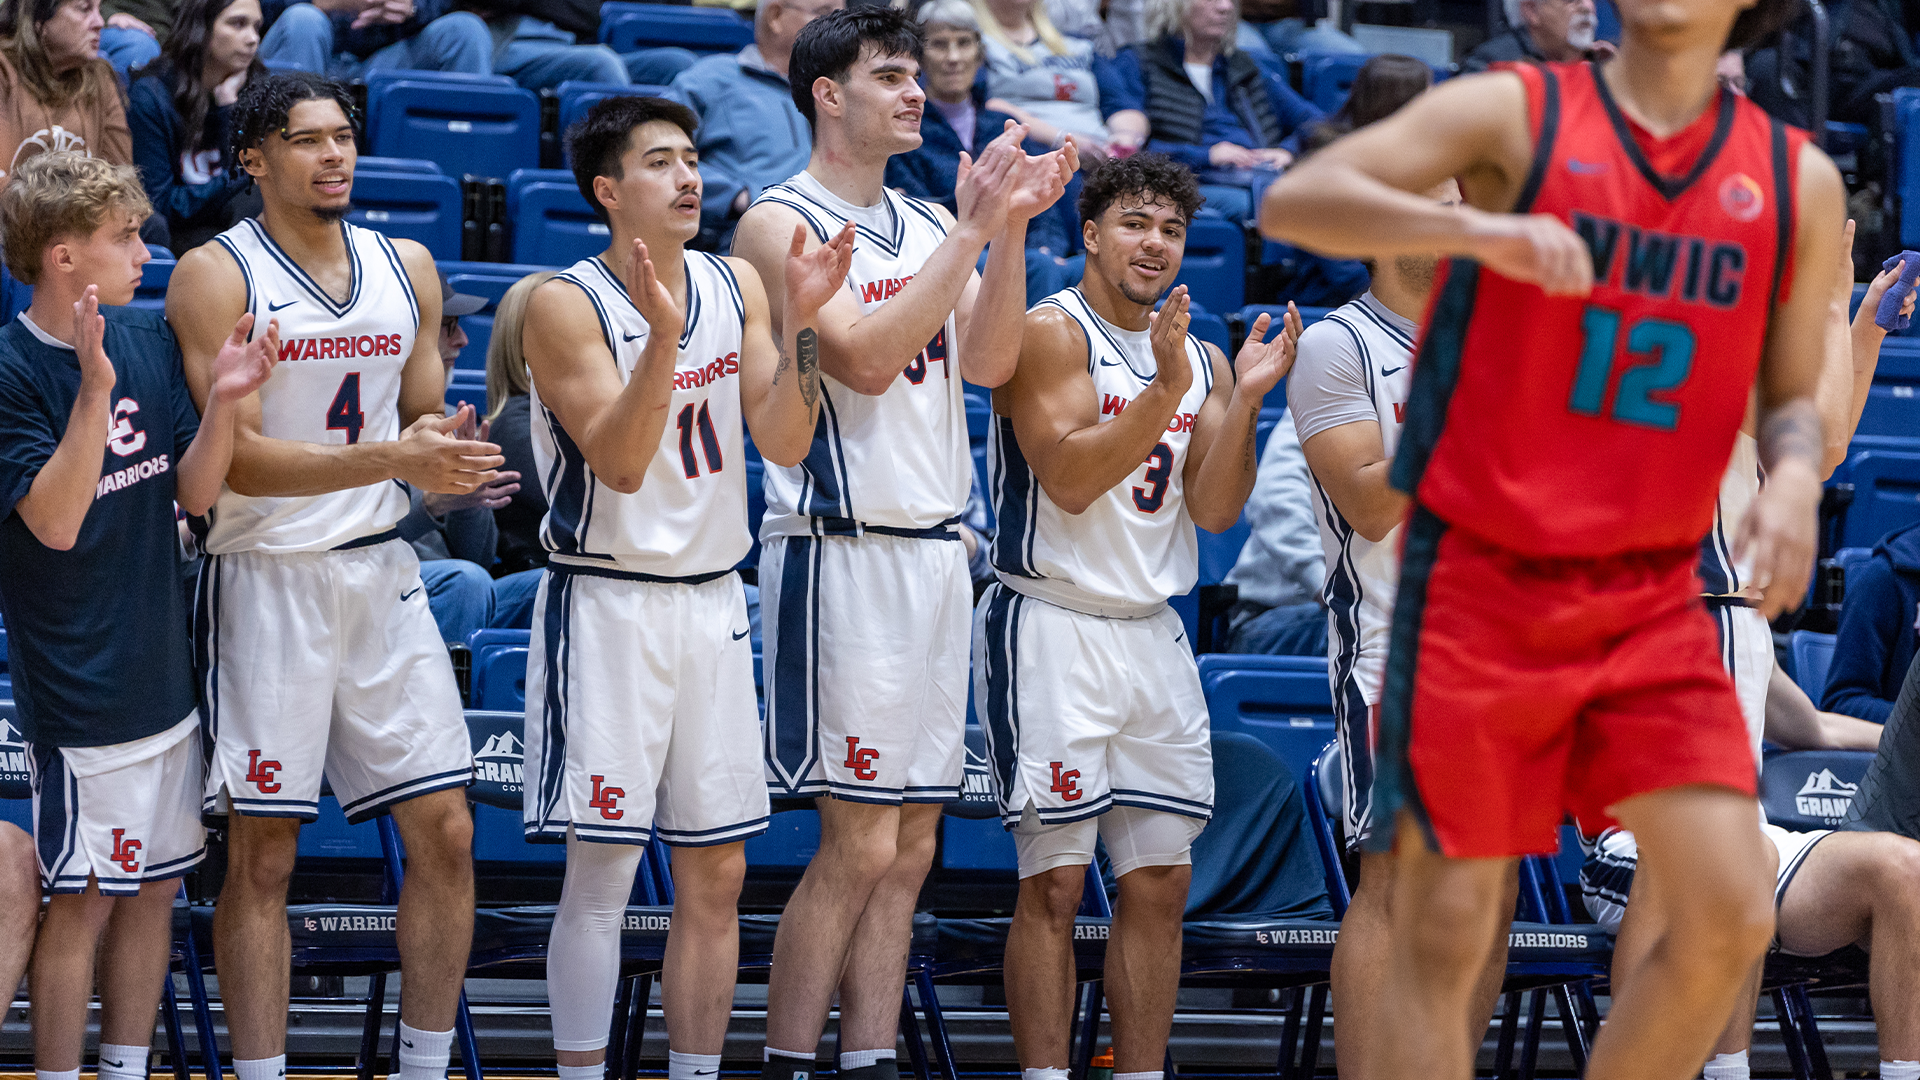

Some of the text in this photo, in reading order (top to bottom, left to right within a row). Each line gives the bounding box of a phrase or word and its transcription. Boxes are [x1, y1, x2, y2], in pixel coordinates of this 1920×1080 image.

[1570, 209, 1748, 310] NWIC
[278, 333, 401, 362] WARRIORS
[1567, 303, 1698, 433] 12
[325, 371, 365, 445] 4
[677, 398, 724, 480] 11
[1131, 441, 1175, 514] 3
[0, 773, 29, 781] ONC
[246, 749, 282, 794] LC
[844, 736, 880, 781] LC
[589, 774, 626, 820] LC
[1050, 761, 1083, 802] LC
[110, 828, 142, 873] LC
